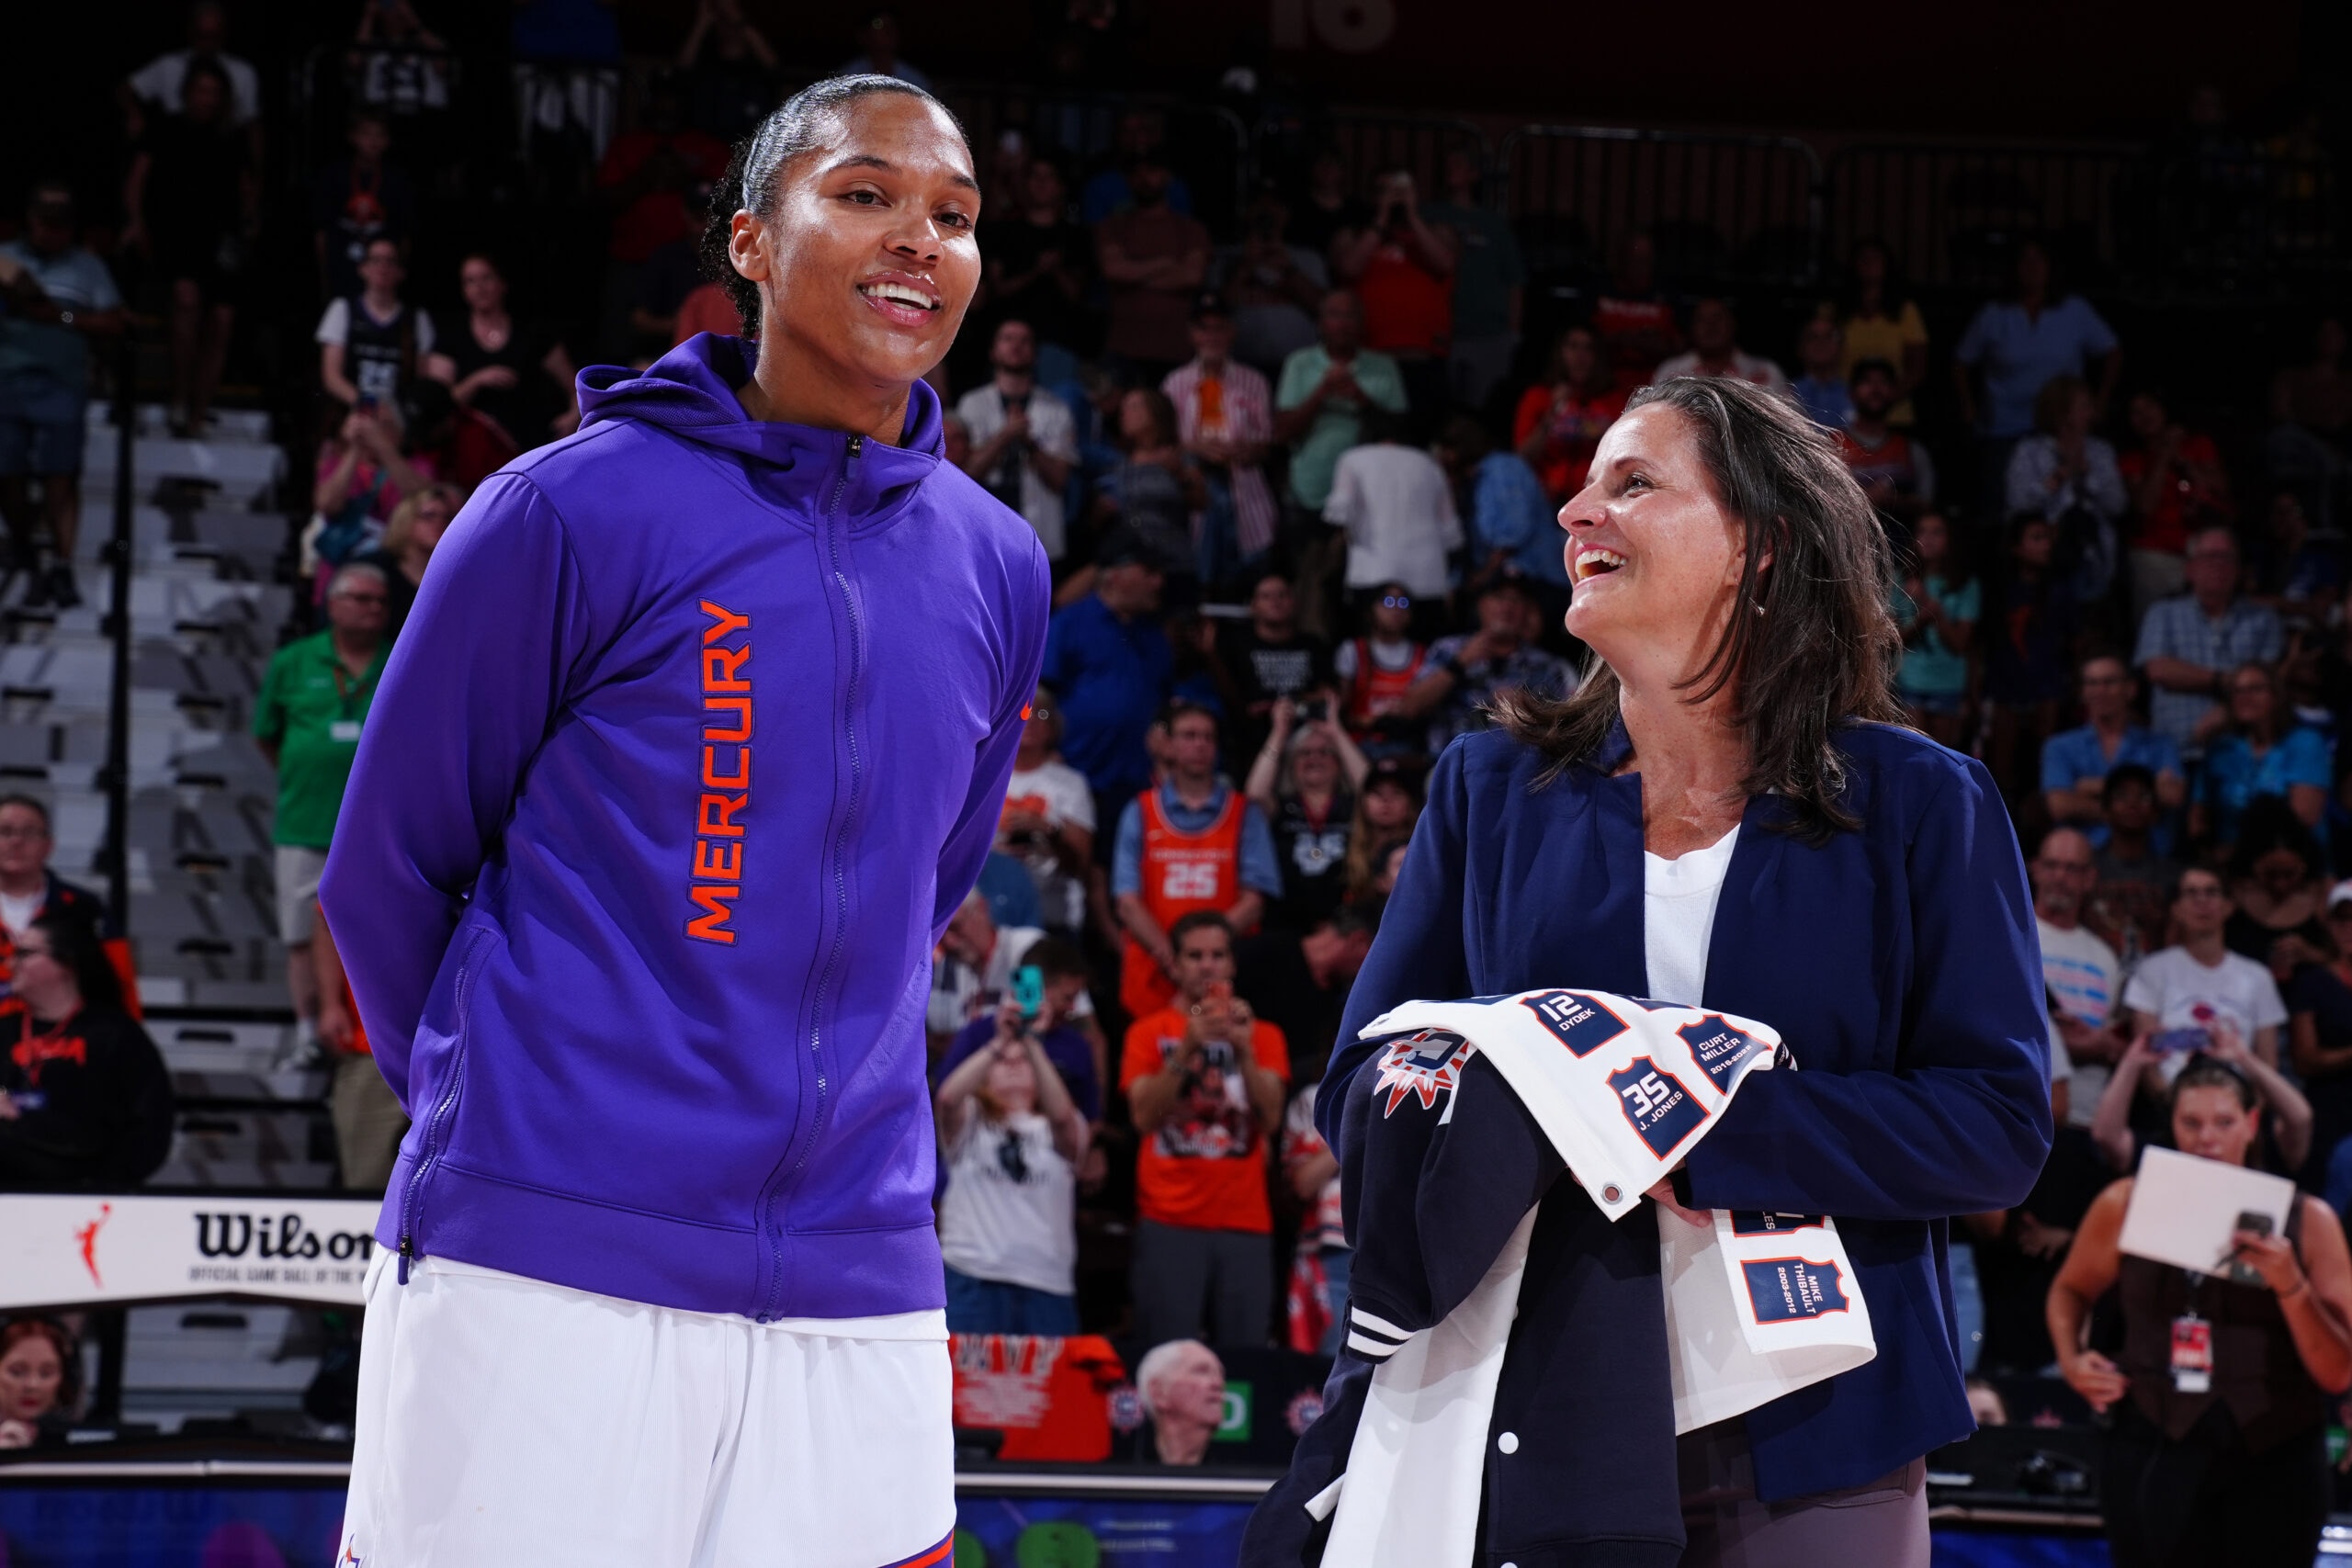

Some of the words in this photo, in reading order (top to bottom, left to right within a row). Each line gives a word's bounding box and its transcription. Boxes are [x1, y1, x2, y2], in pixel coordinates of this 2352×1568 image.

[685, 598, 752, 944] MERCURY
[1162, 862, 1220, 899] 25
[1539, 994, 1583, 1022] 12
[1558, 1008, 1596, 1032] DYDEK
[1698, 1032, 1728, 1051] CURT
[1700, 1037, 1741, 1062] MILLER
[1621, 1070, 1670, 1119] 35
[1639, 1121, 1651, 1132] J.
[1651, 1090, 1684, 1123] JONES
[1777, 1266, 1797, 1314] 2003-2012
[1794, 1263, 1817, 1314] THIBAULT
[1806, 1274, 1824, 1303] MIKE
